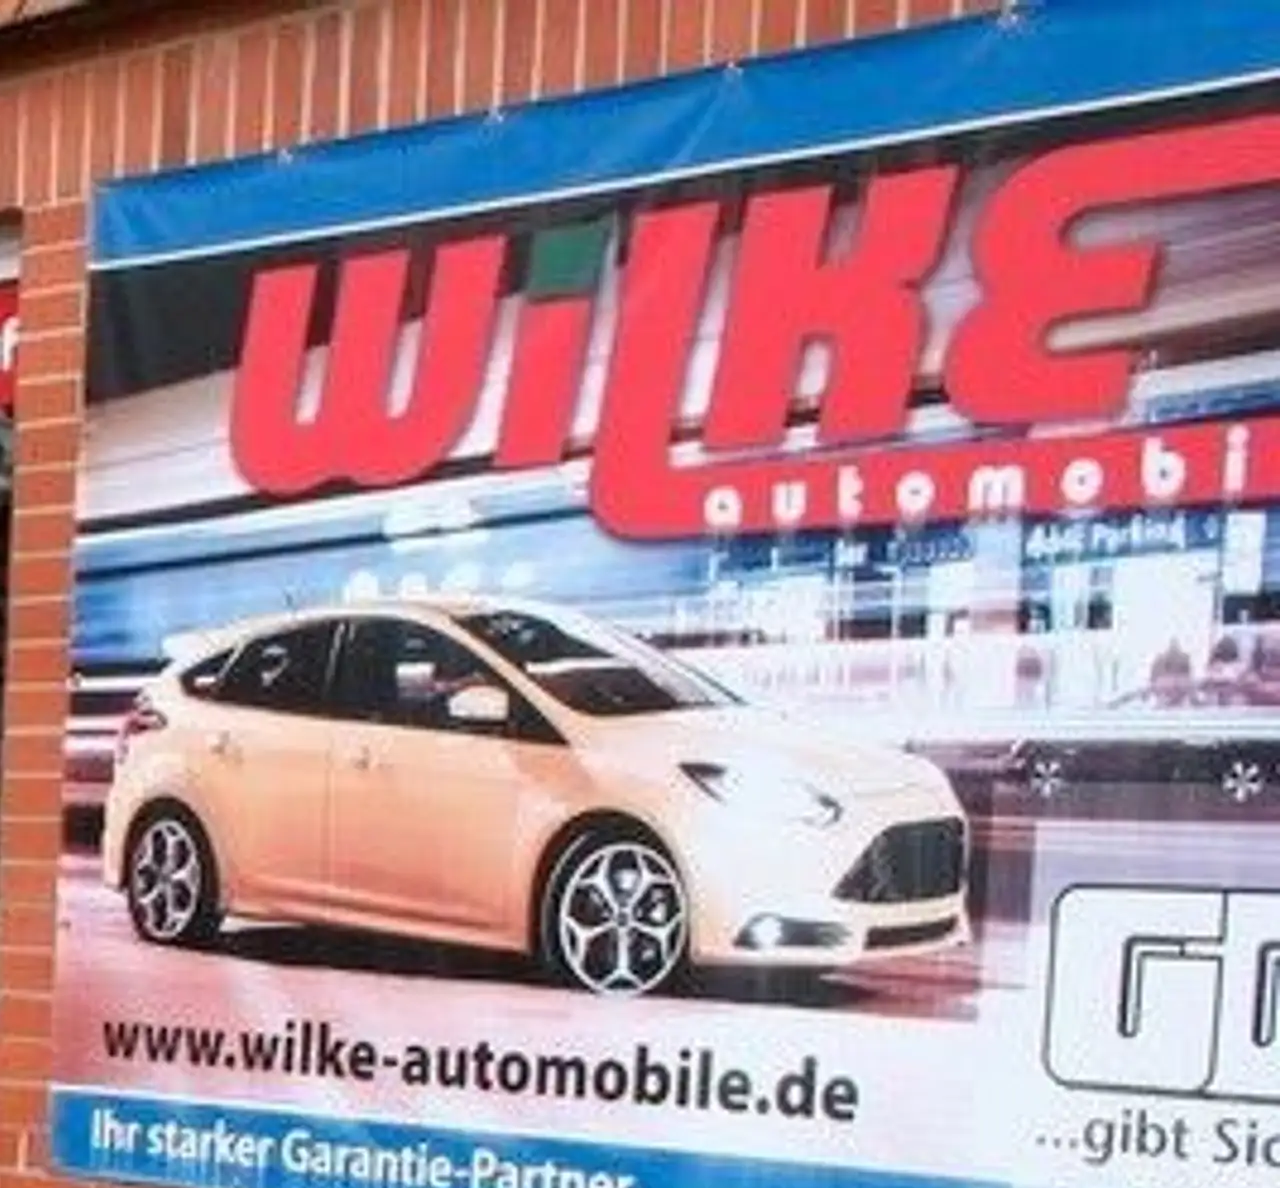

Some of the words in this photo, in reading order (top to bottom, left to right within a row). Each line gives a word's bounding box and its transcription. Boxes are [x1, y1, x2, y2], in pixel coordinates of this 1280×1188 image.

[101, 1017, 861, 1121] www.wilke-automobile.de
[91, 1109, 141, 1152] Ihr
[146, 1122, 274, 1170] starker
